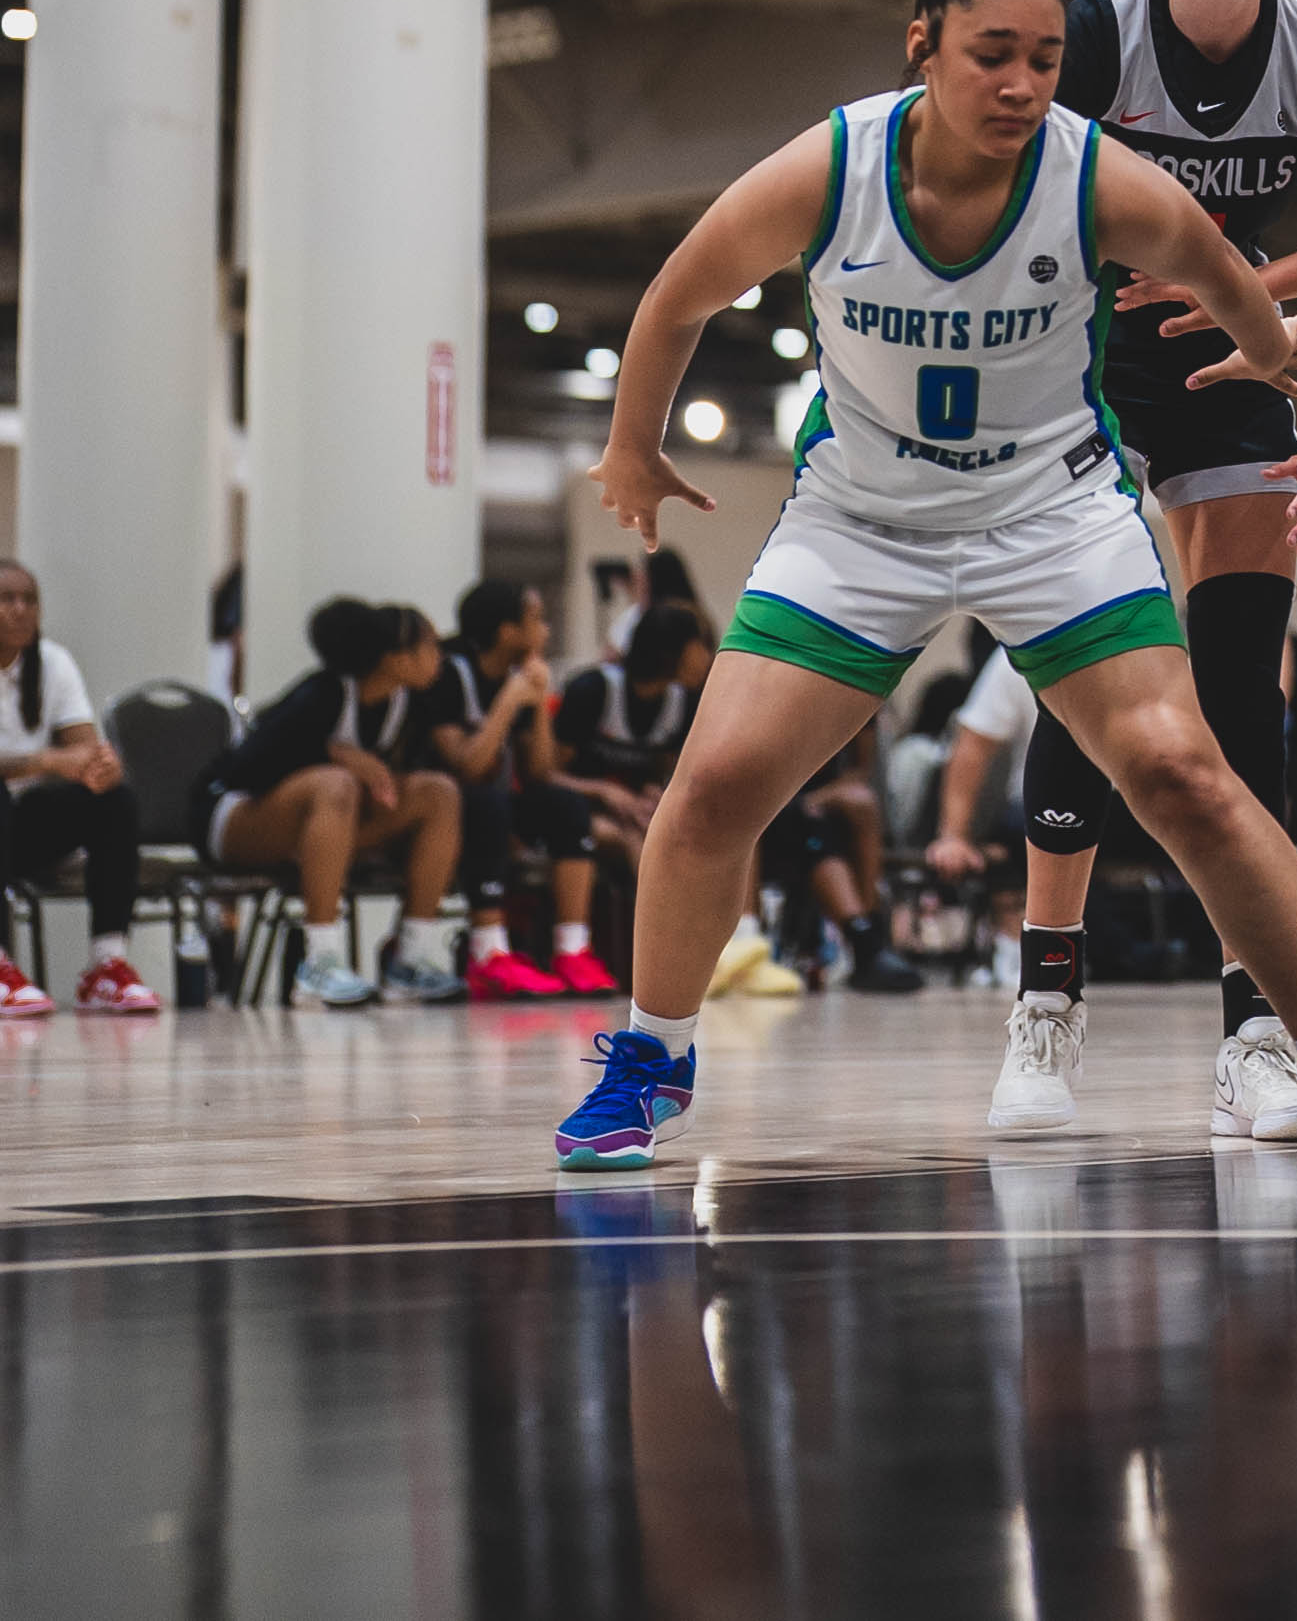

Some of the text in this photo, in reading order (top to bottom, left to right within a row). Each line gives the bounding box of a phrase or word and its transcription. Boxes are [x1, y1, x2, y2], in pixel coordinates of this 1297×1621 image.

[1136, 150, 1297, 196] OSKILLS
[842, 297, 1059, 351] SPORTS CITY
[916, 364, 980, 441] 0
